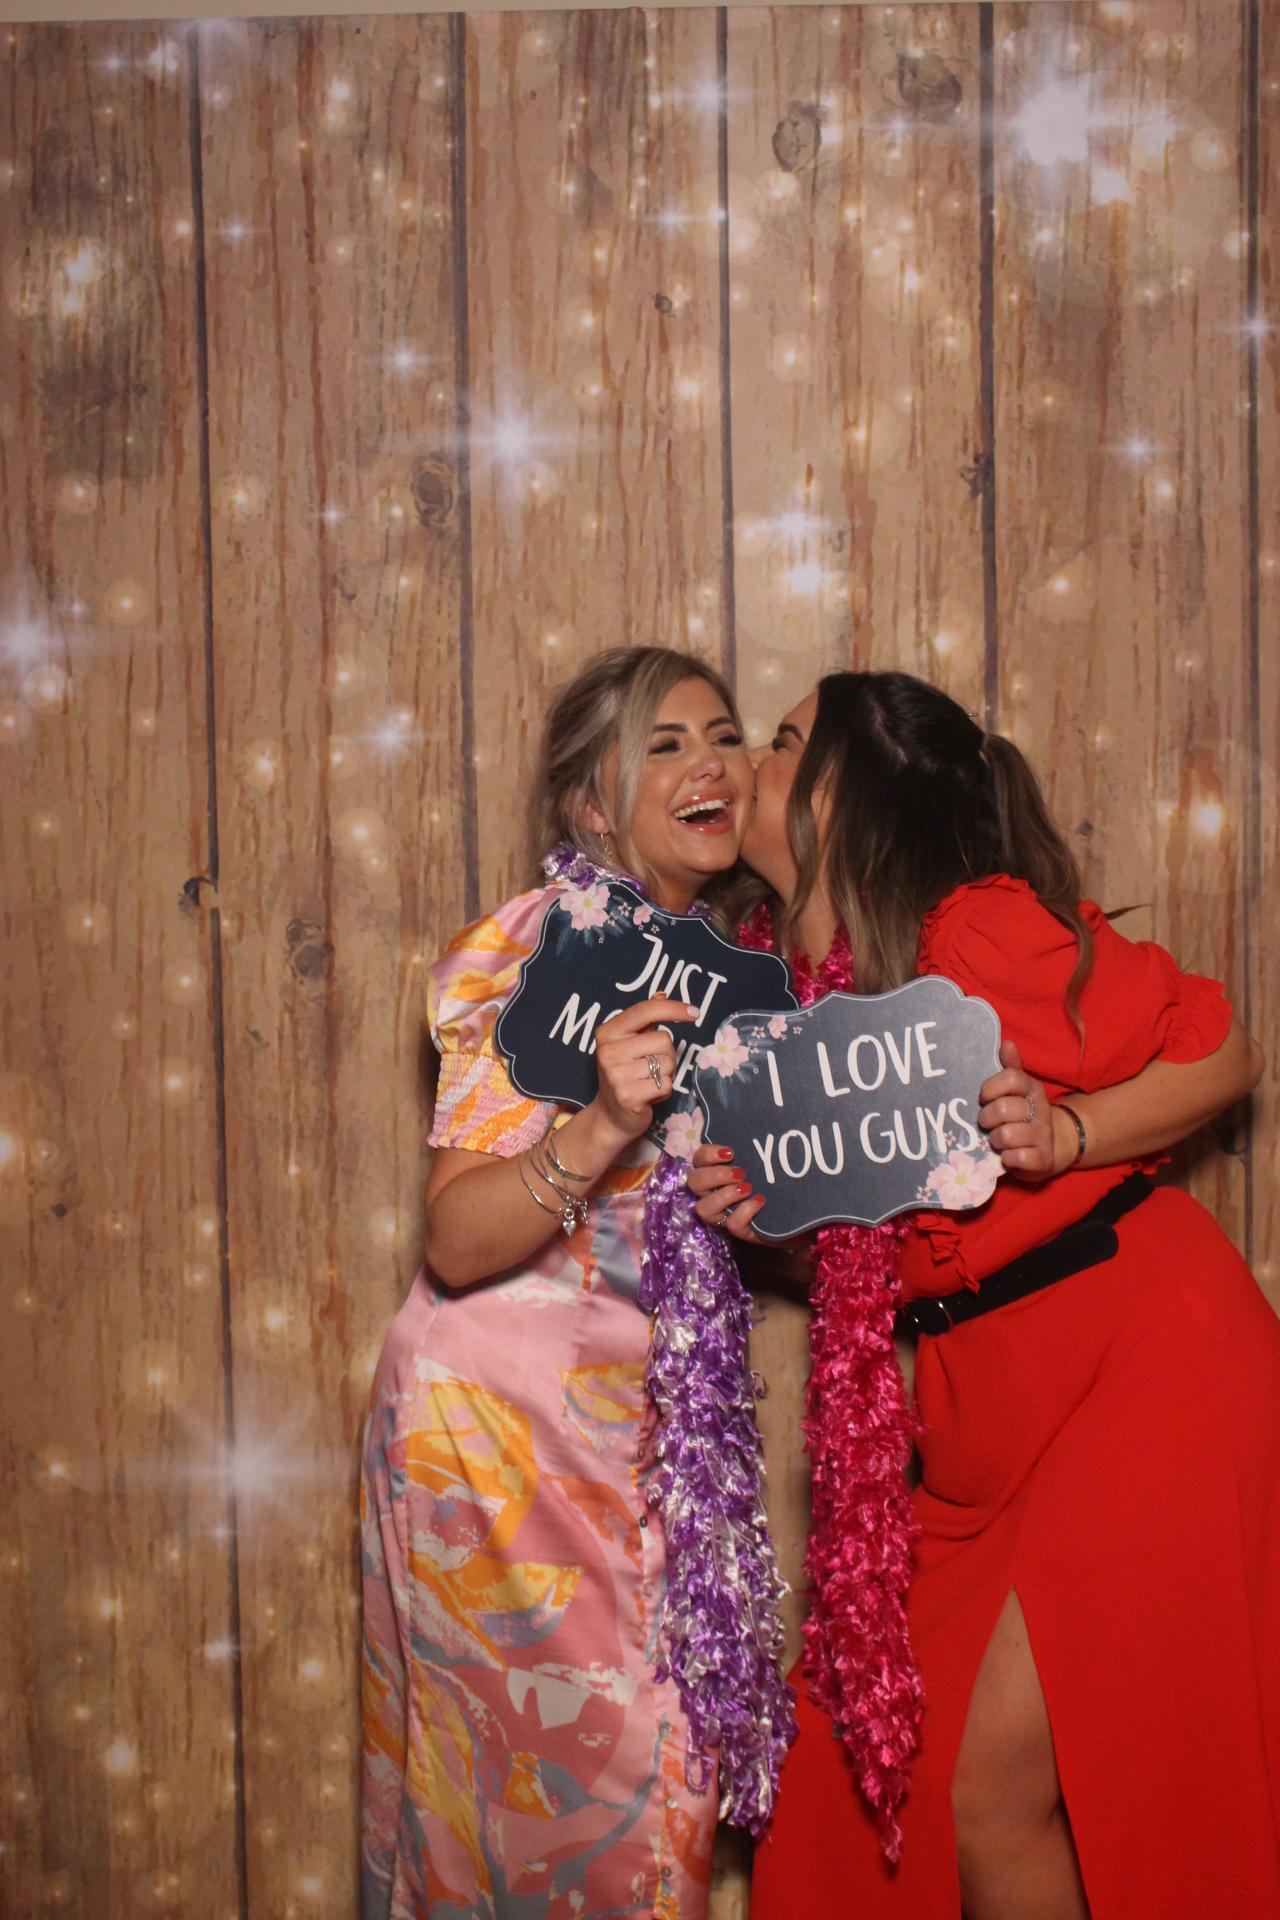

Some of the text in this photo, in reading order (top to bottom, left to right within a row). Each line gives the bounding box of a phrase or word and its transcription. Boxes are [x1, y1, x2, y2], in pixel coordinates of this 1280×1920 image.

[615, 932, 728, 1028] JUST
[766, 1021, 946, 1108] I LOVE
[752, 1097, 979, 1185] YOU GUYS
